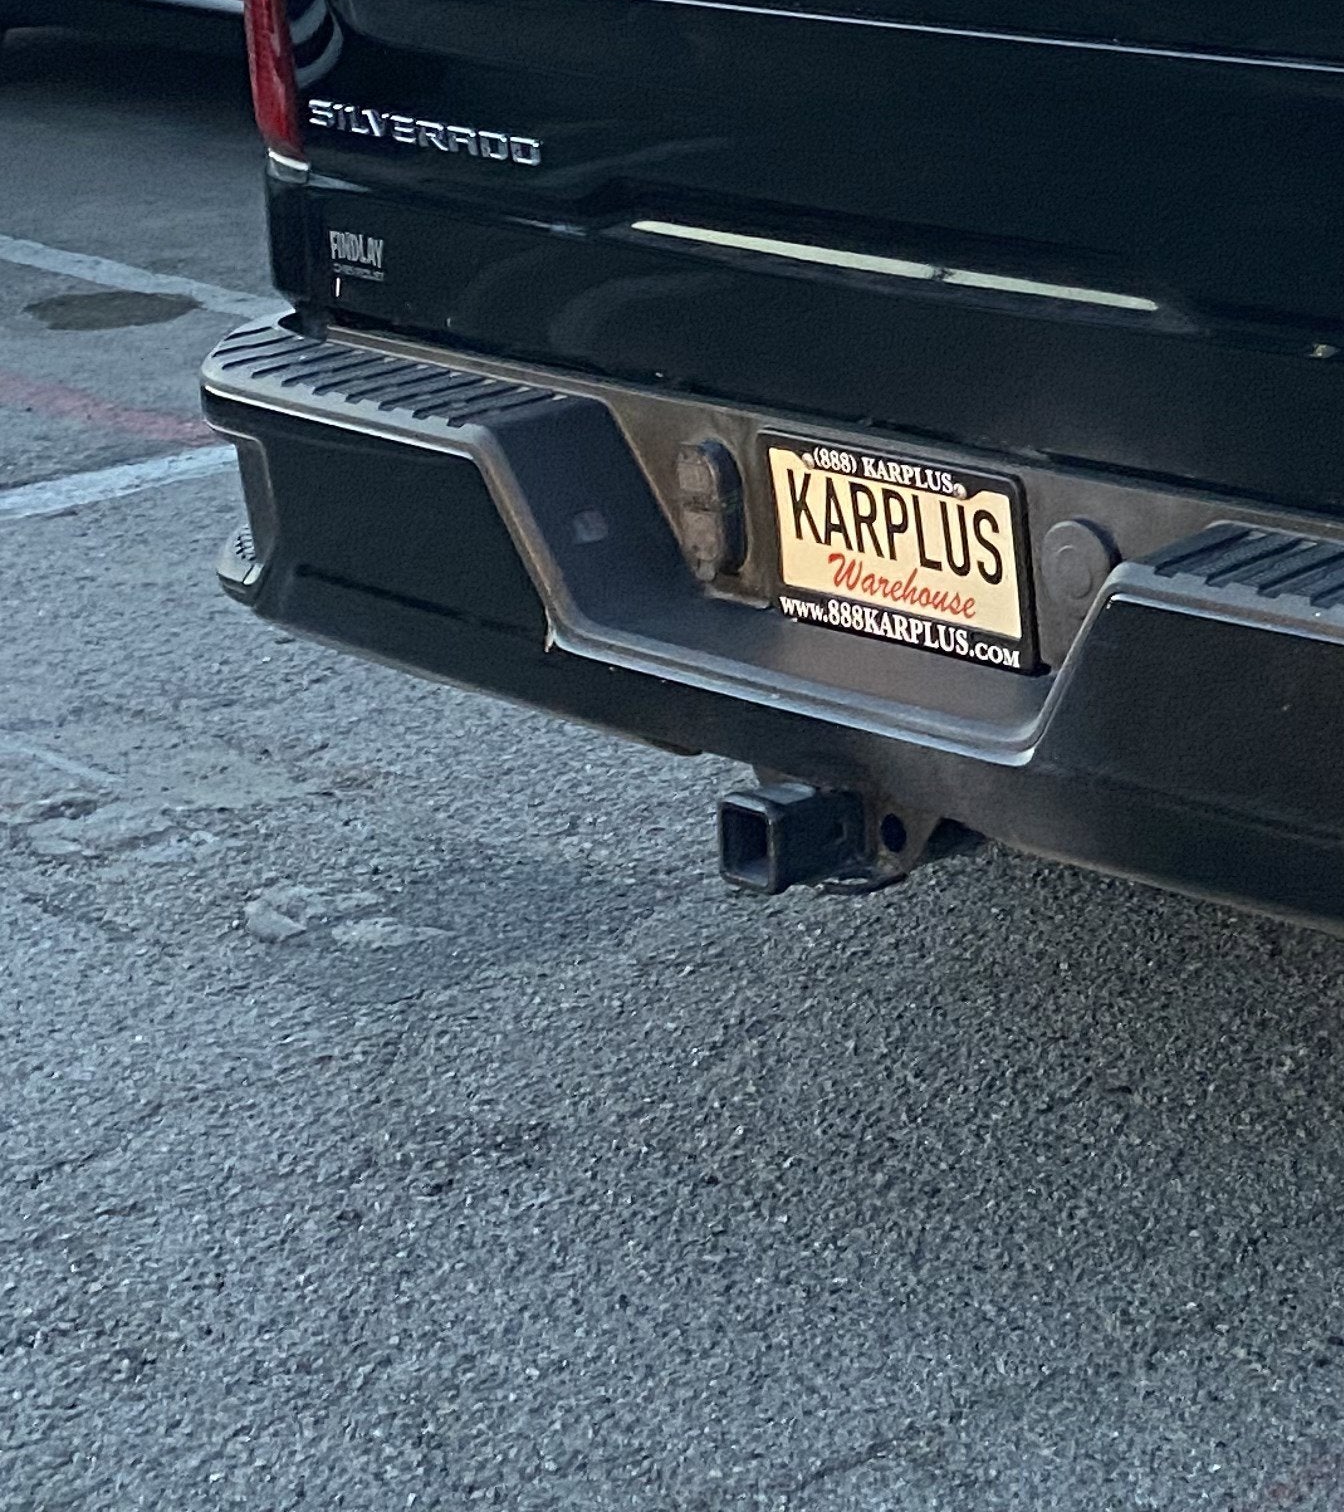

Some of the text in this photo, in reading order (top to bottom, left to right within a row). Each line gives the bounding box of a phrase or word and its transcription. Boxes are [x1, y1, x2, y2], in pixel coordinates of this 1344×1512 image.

[308, 98, 544, 167] SILVERADO
[329, 230, 384, 269] FINDLAY
[813, 446, 954, 495] (888) KARPLUS
[787, 467, 1004, 586] KARPLUS
[826, 552, 978, 620] Warehouse
